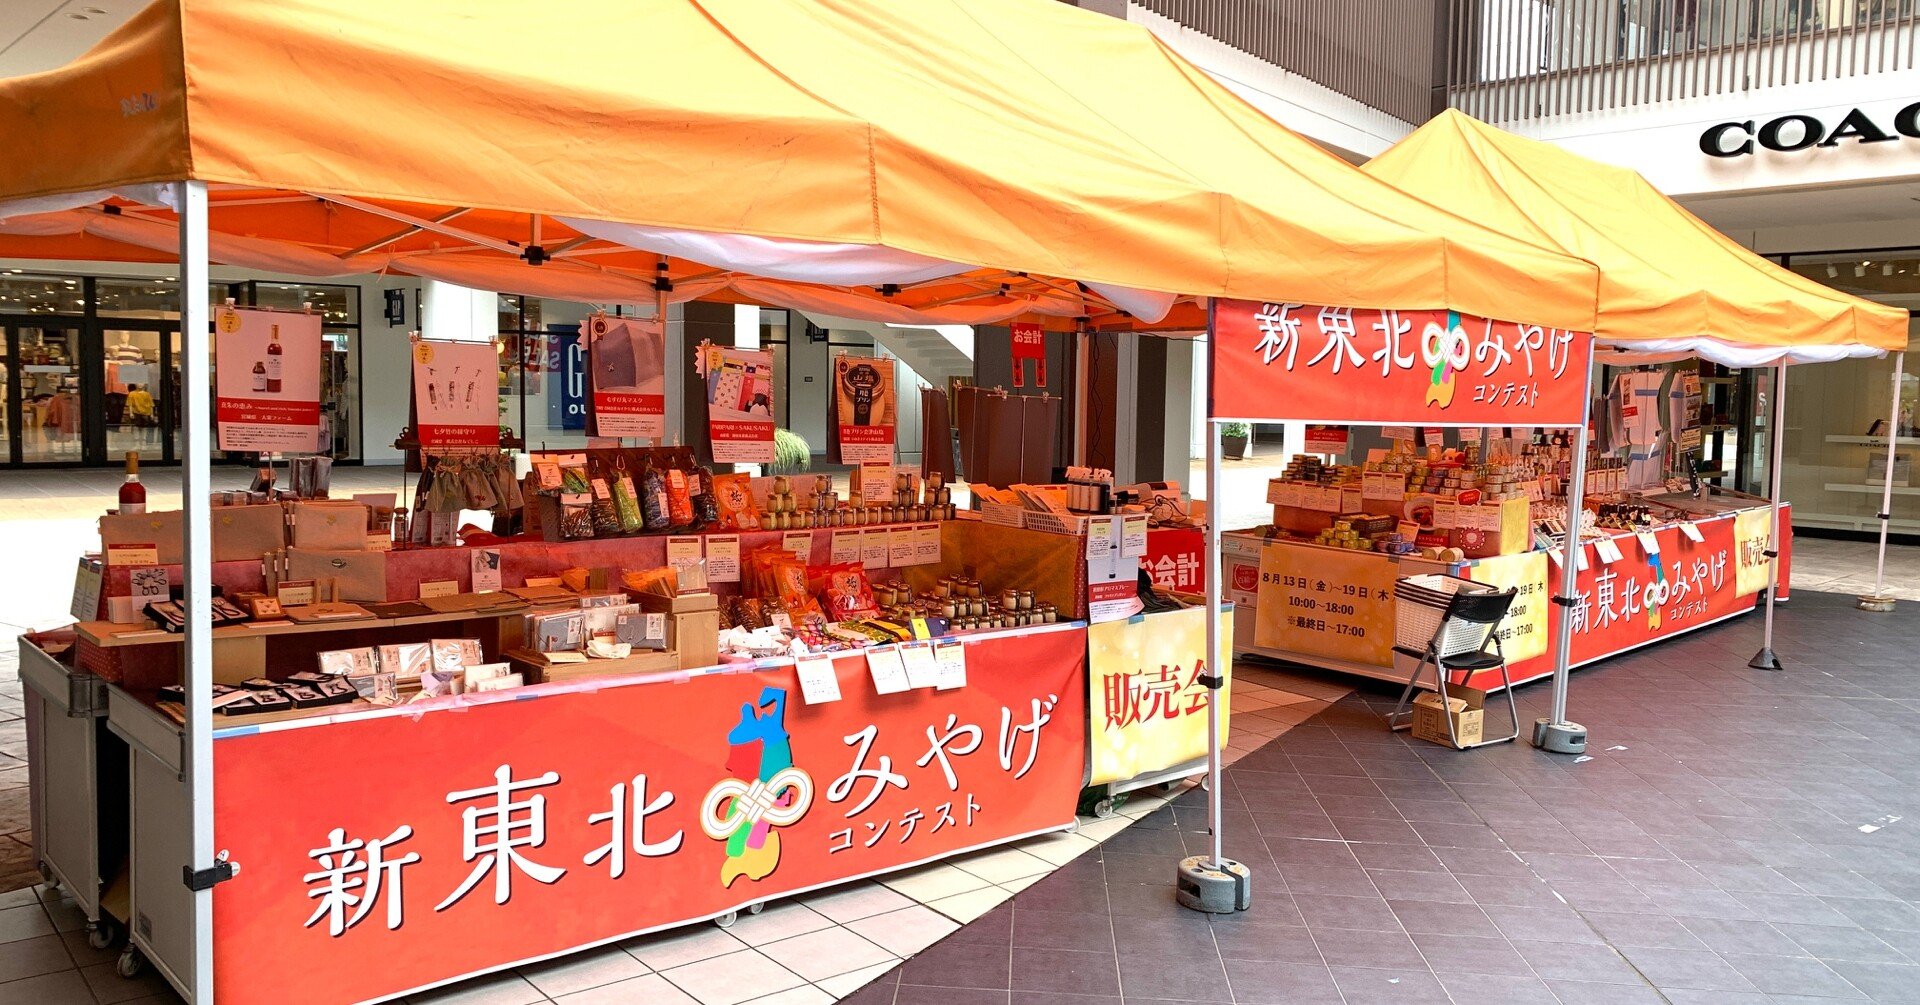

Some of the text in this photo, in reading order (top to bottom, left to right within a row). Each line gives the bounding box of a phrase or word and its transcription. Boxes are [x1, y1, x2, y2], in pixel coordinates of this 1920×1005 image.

[1013, 329, 1042, 344] お会計
[1473, 382, 1539, 408] コンテスト
[1571, 550, 1728, 634] 新東北 みやげ
[1670, 596, 1708, 620] コンテスト
[1103, 659, 1209, 732] 販売会
[302, 694, 1059, 938] 新東北 みやげ
[828, 793, 982, 853] コンテスト
